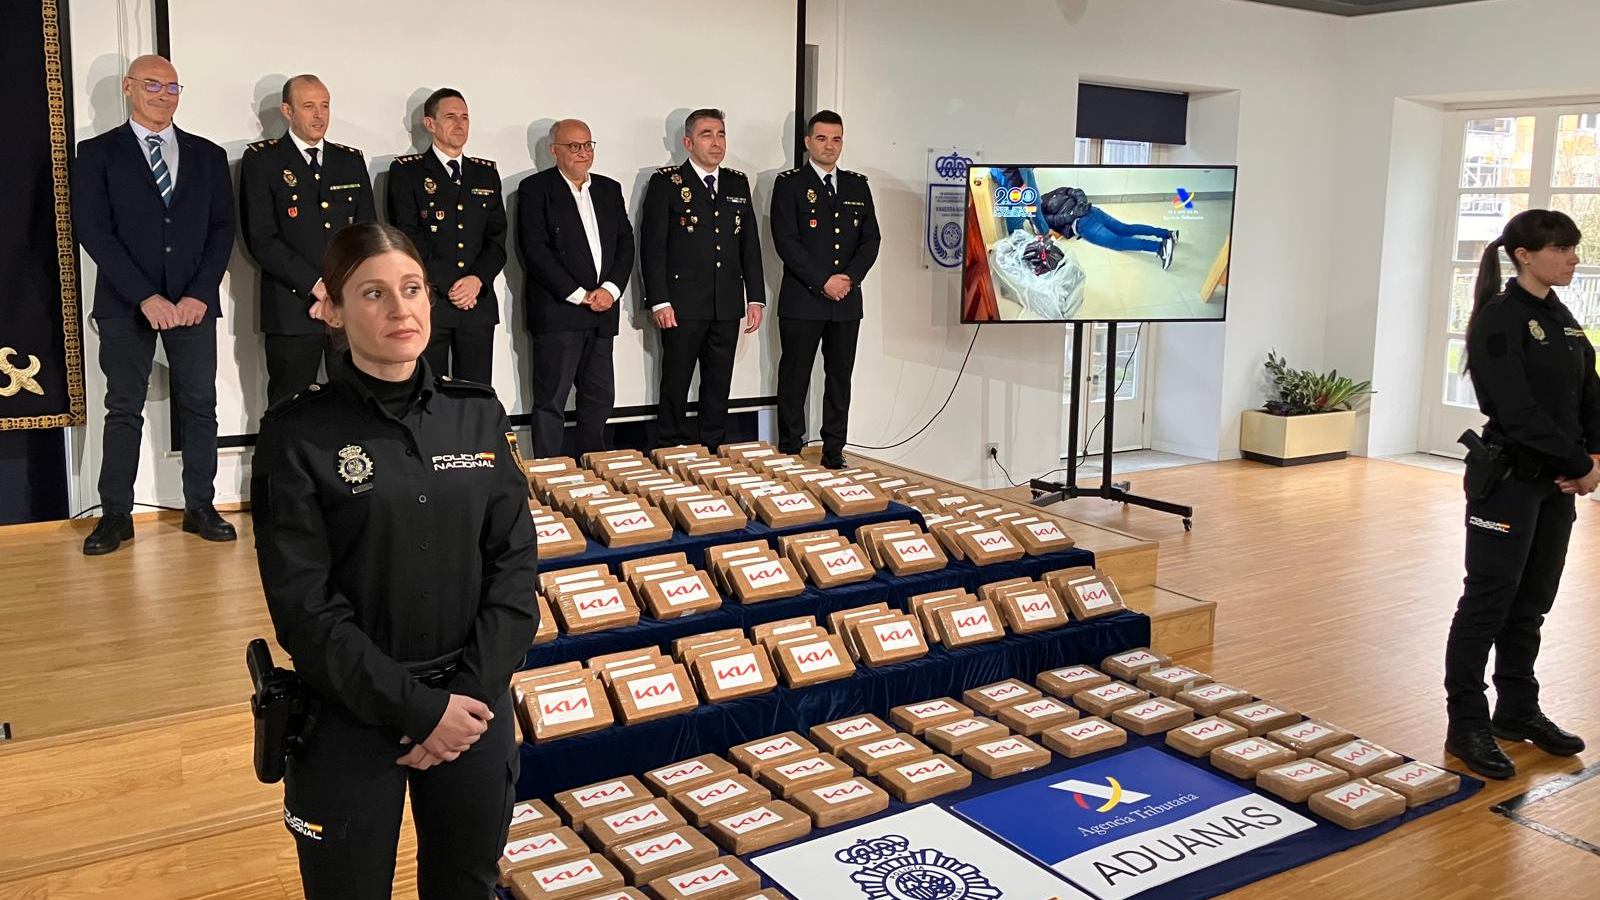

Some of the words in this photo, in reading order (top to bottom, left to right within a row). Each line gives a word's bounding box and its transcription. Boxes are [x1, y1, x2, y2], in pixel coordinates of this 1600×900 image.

[432, 453, 483, 463] POLICIA
[434, 460, 495, 470] NACIONAL
[1078, 815, 1135, 837] Agencia
[1130, 792, 1199, 820] Tributaria
[1092, 806, 1283, 886] ADUANAS
[889, 864, 925, 880] POLICÍA
